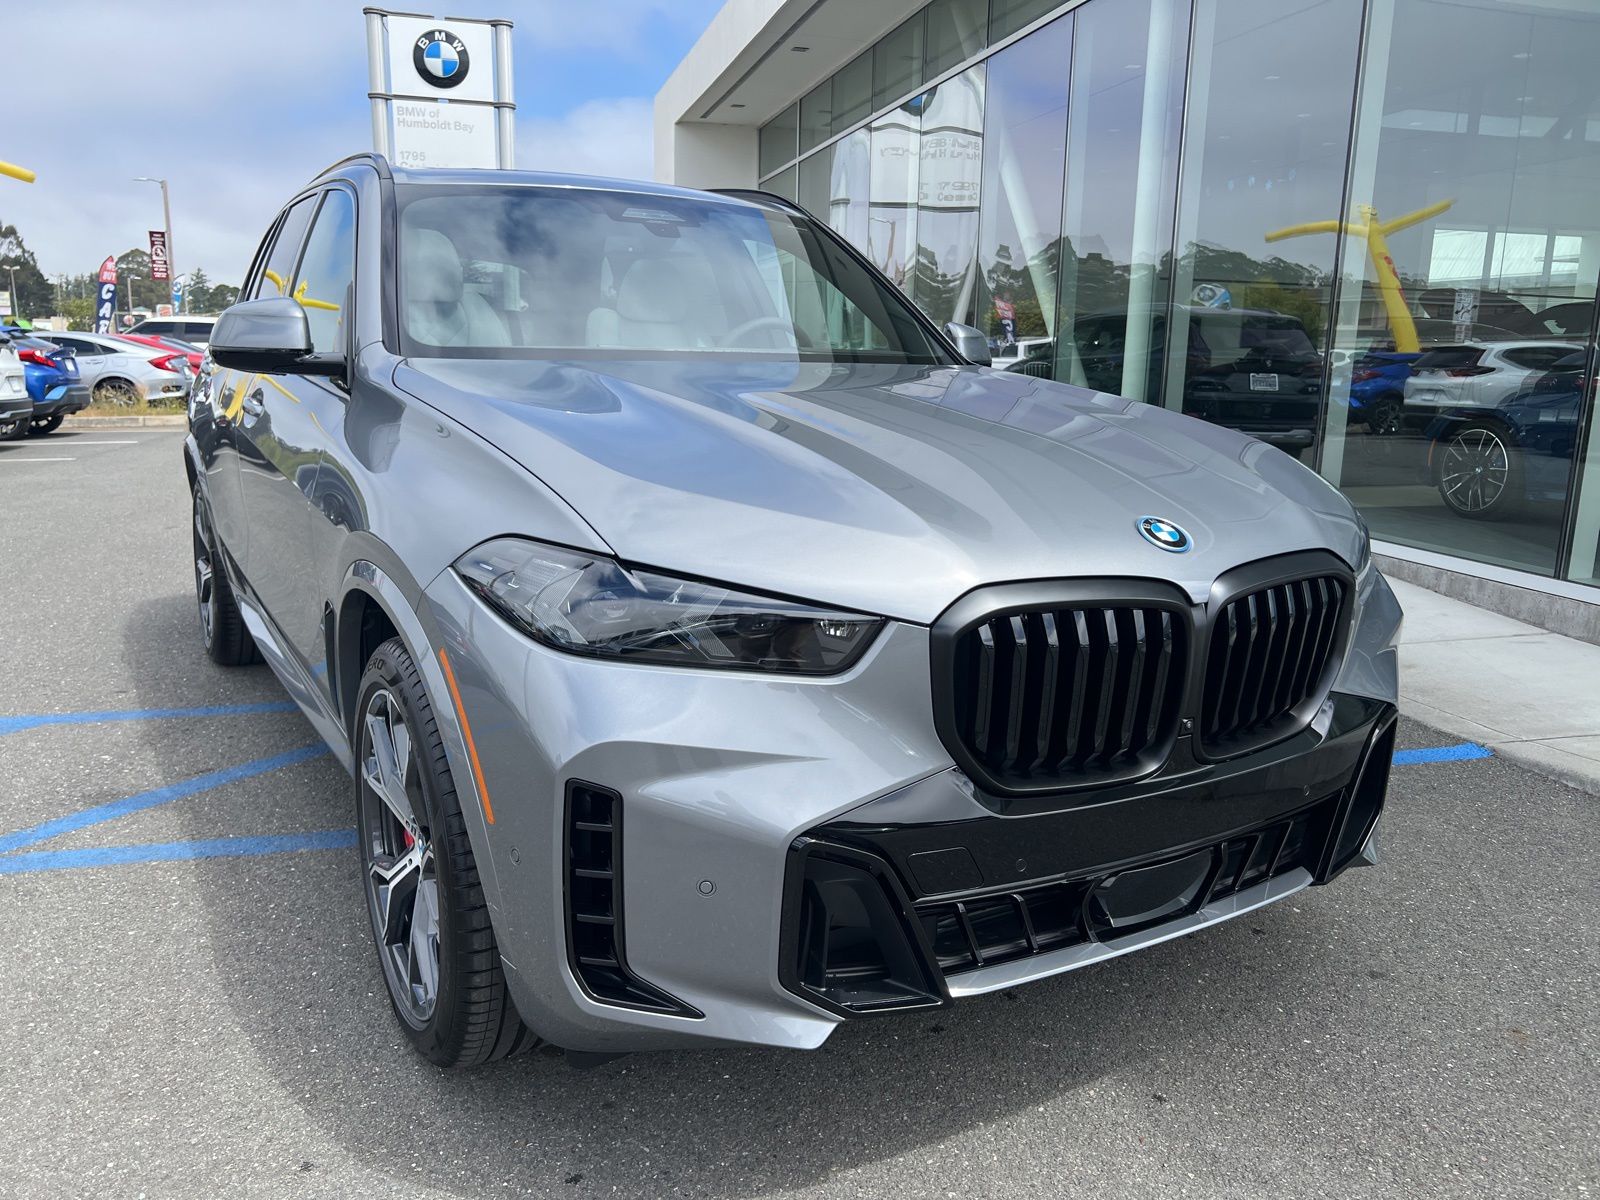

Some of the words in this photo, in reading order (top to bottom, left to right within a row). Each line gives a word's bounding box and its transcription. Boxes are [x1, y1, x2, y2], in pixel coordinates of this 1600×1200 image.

[417, 31, 464, 52] BMW
[397, 106, 426, 117] BMW
[429, 109, 440, 118] of
[397, 118, 452, 131] Humboldt
[454, 121, 474, 135] Bay
[399, 150, 426, 161] 1795
